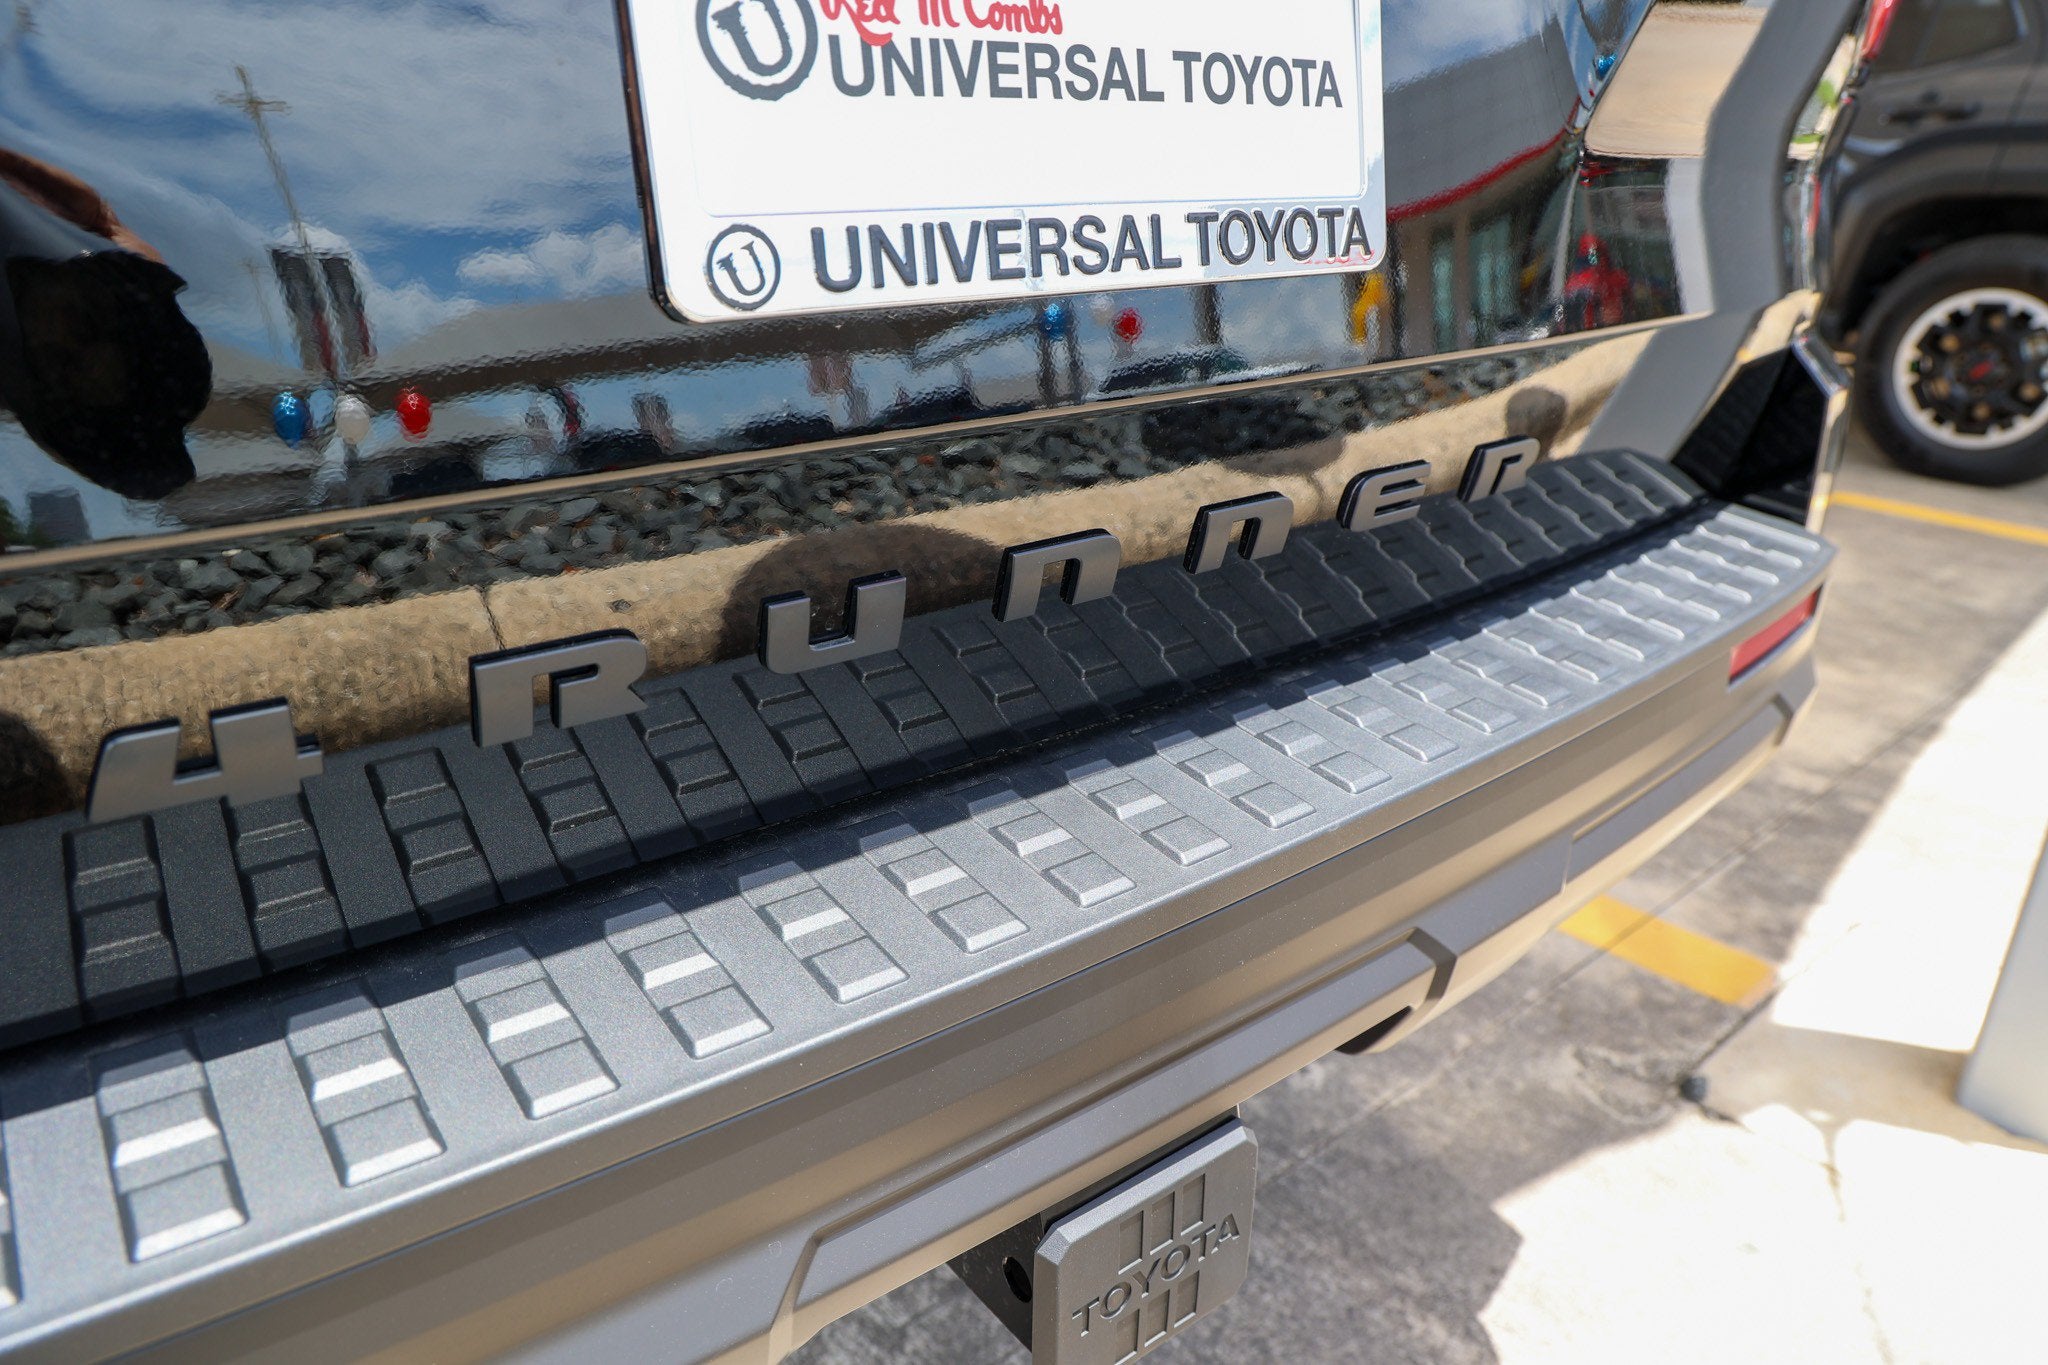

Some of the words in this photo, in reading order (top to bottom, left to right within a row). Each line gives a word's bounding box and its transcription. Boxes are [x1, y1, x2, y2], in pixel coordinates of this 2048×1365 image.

[827, 34, 1165, 102] UNIVERSAL
[1172, 50, 1343, 108] TOYOTA
[810, 213, 1182, 293] UNIVERSAL
[1186, 206, 1372, 267] TOYOTA
[1071, 1213, 1240, 1337] TOYOTA
